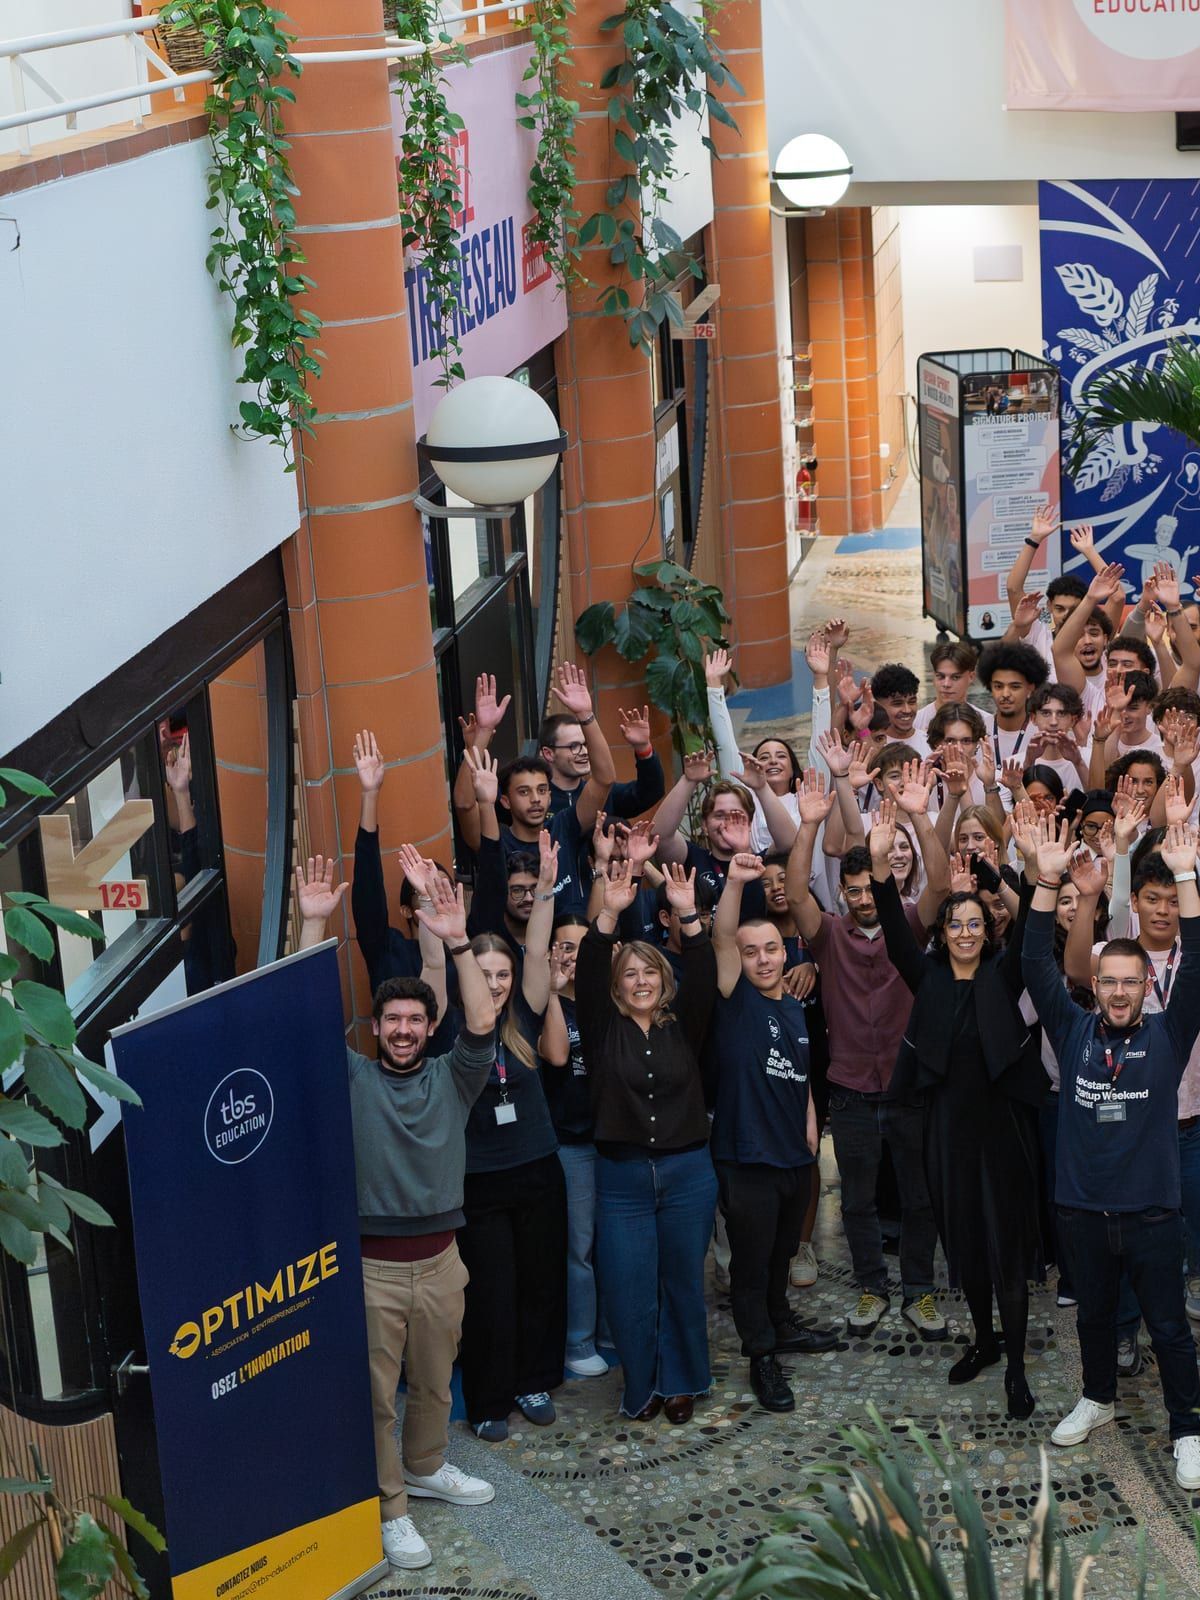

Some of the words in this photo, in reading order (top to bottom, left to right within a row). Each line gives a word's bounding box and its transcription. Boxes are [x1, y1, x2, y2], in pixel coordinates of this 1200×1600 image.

[693, 324, 713, 338] 126
[972, 414, 1017, 425] SIGNATURE
[1018, 412, 1052, 423] PROJECT
[98, 883, 142, 908] 125
[220, 1088, 256, 1125] tbs
[1102, 1089, 1149, 1101] Weekend
[215, 1113, 266, 1149] EDUCATION
[168, 1241, 339, 1359] OPTIMIZE
[211, 1370, 238, 1400] OSEZ
[239, 1329, 311, 1384] L'INNOVATION
[216, 1567, 251, 1597] CONTACTEZ
[250, 1555, 268, 1575] NOUS
